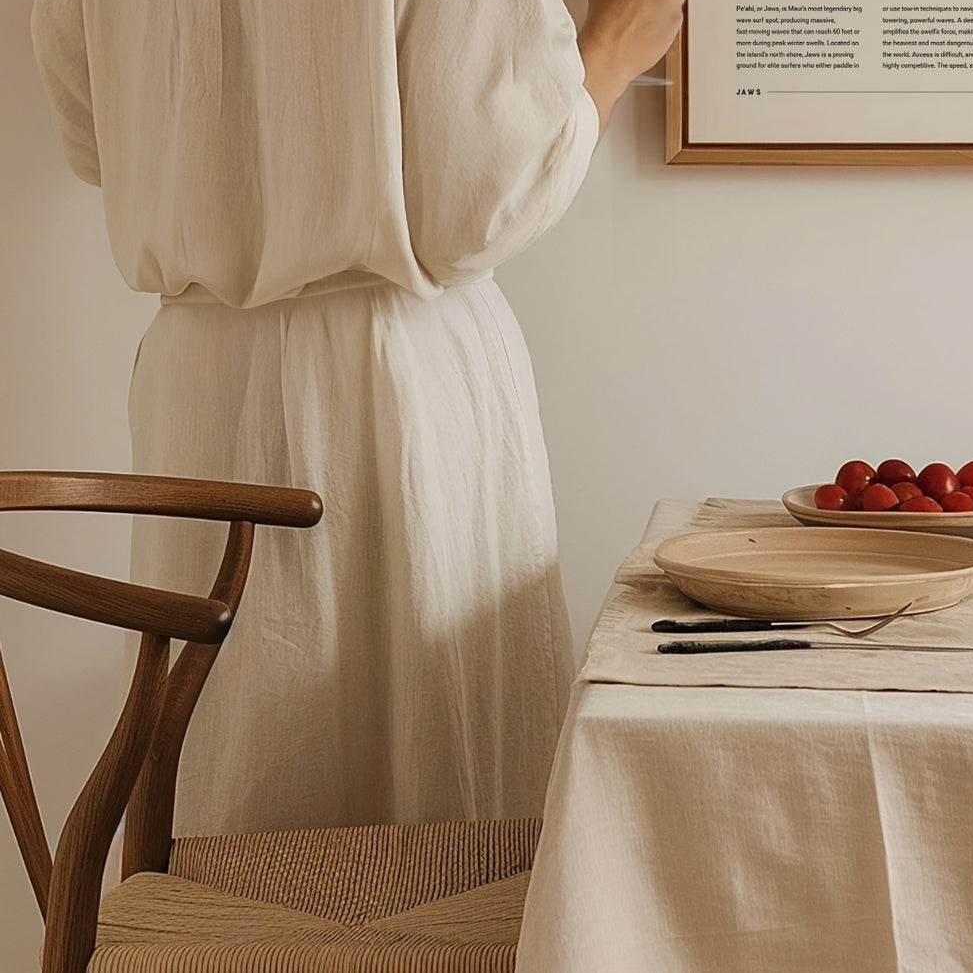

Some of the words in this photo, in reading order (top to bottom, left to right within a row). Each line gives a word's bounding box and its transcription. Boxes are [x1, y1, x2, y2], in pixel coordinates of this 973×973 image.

[763, 5, 781, 13] Jaws,
[823, 5, 853, 13] legendary
[852, 5, 863, 13] big
[920, 5, 952, 13] techniques
[752, 16, 764, 24] surf
[765, 17, 780, 25] spot,
[780, 17, 810, 25] producing
[882, 17, 910, 25] towering,
[909, 17, 936, 25] powerful
[832, 27, 841, 35] 60
[882, 27, 910, 36] amplifies
[940, 27, 958, 36] force,
[752, 39, 771, 48] during
[771, 39, 786, 48] peak
[832, 51, 854, 60] proving
[736, 62, 757, 70] ground
[757, 61, 767, 69] for
[780, 61, 802, 69] surfers
[833, 62, 853, 70] paddle
[882, 62, 900, 70] highly
[900, 62, 936, 70] competitive.
[937, 61, 949, 69] The
[949, 62, 969, 70] speed,
[736, 88, 761, 96] JAWS
